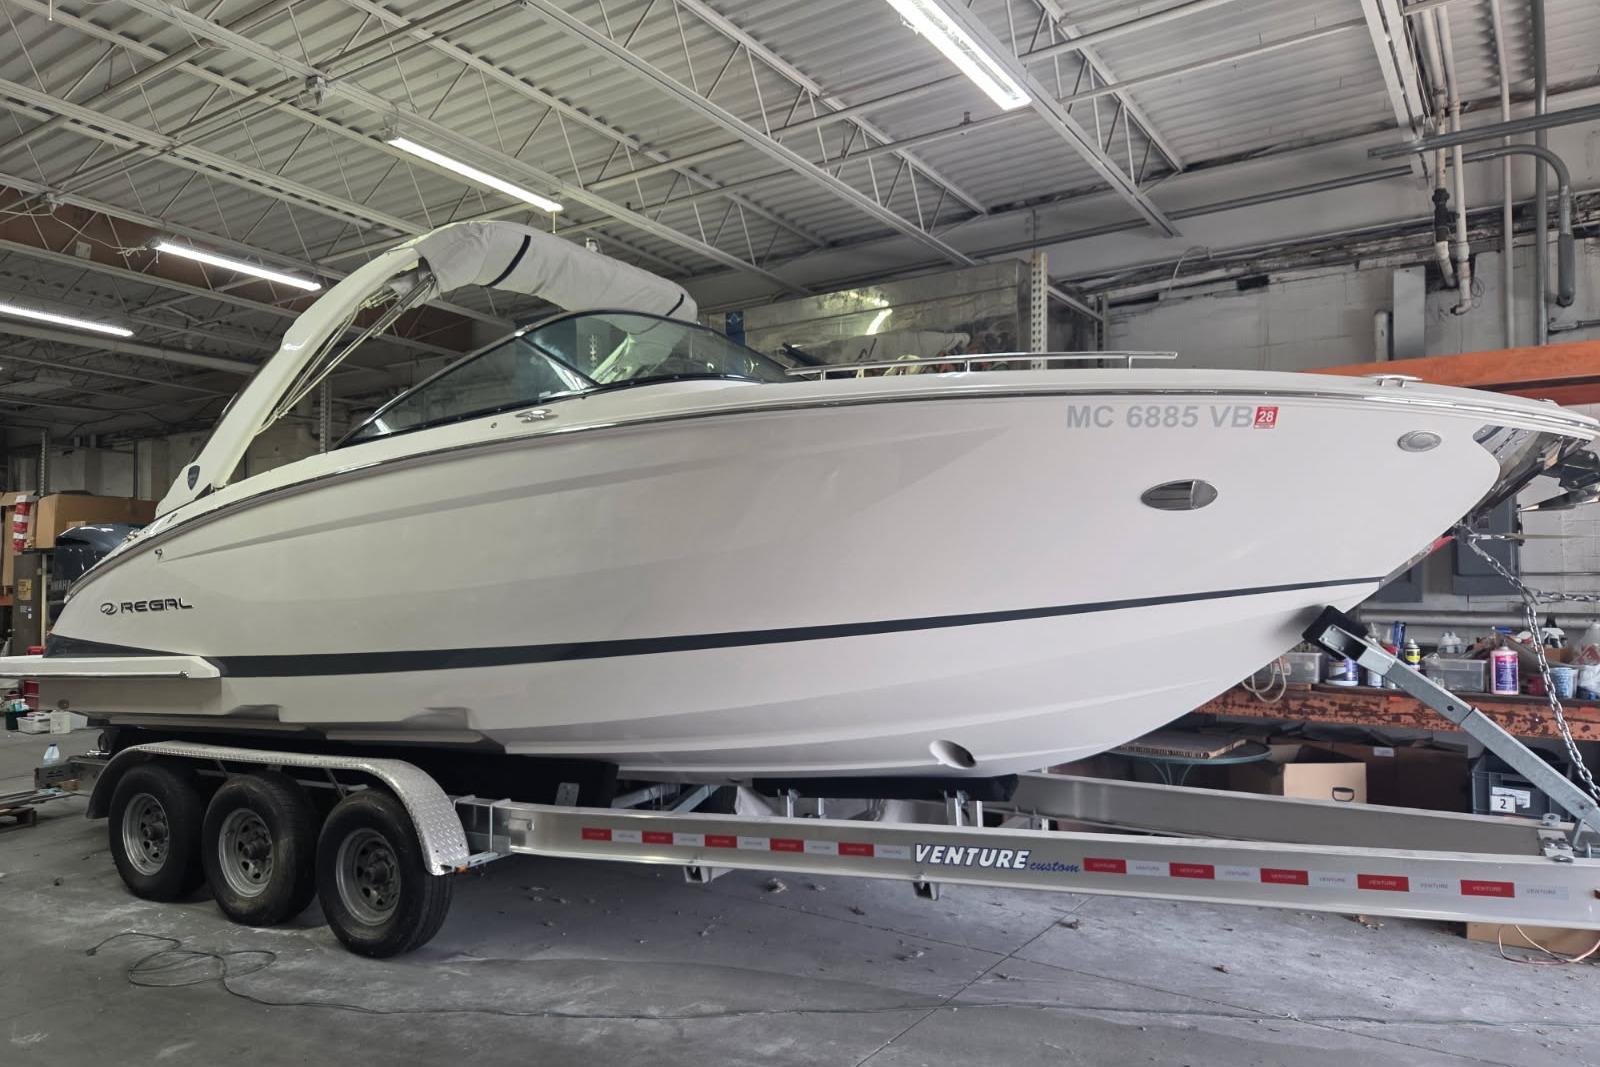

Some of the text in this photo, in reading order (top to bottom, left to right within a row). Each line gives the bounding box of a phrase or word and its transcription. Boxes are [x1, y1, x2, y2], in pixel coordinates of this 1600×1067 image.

[1066, 405, 1253, 428] MC 6885 VB
[1257, 410, 1274, 423] 28
[120, 597, 193, 613] REGAL
[1499, 798, 1507, 809] 2
[914, 844, 1080, 873] VENTURE custom
